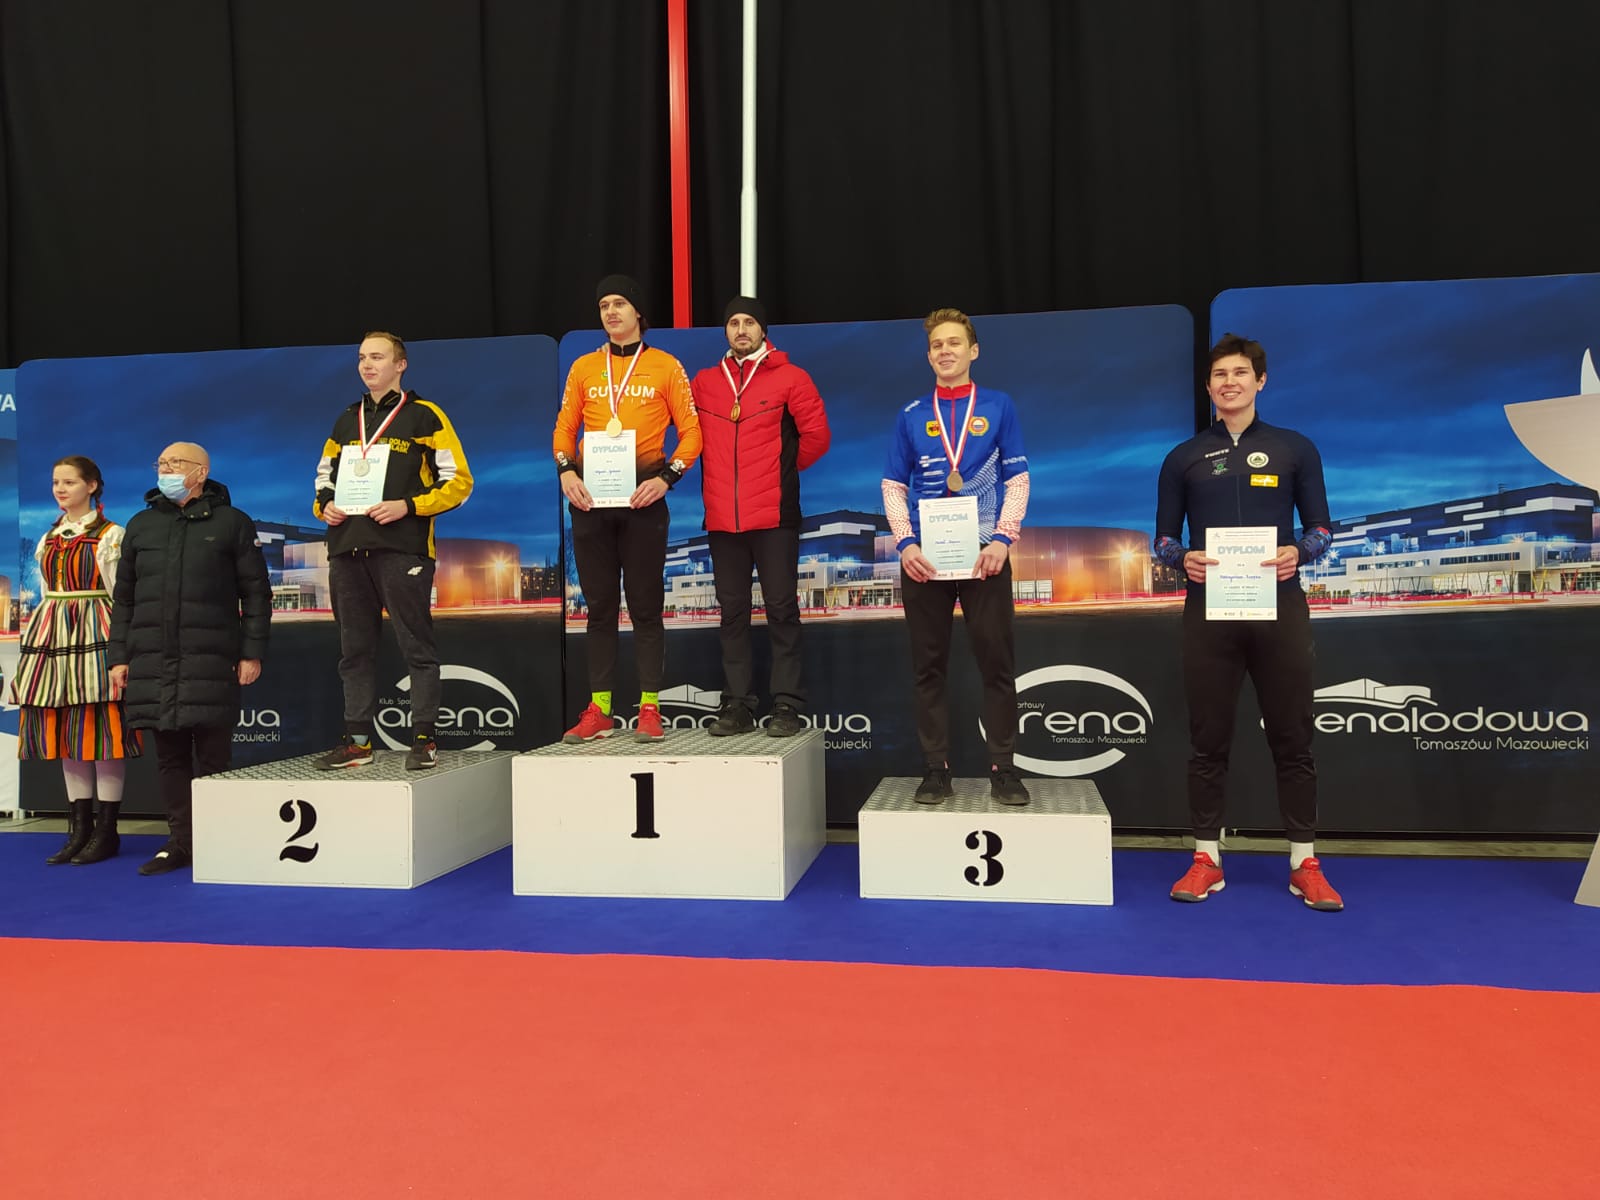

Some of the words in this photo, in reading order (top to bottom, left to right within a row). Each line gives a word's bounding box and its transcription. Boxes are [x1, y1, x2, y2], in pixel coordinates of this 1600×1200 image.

[588, 384, 656, 400] CUPRUM
[592, 445, 627, 453] DYPLOM
[347, 457, 380, 465] DYOM
[929, 512, 968, 523] DYPLOM
[1217, 545, 1266, 555] DYPLOM
[379, 697, 394, 705] Klub
[1017, 702, 1045, 710] ortowy
[1018, 711, 1147, 735] rena
[1312, 706, 1589, 734] enalodowa
[232, 731, 281, 743] zowiecki
[434, 728, 470, 737] Tomaszów
[473, 728, 514, 737] Mazowiecki
[824, 737, 872, 750] owiecki
[1052, 735, 1094, 745] Tomaszów
[1098, 735, 1147, 745] Mazowiecki
[1412, 736, 1492, 751] Tomaszów
[1496, 736, 1590, 751] Mazowiecki
[630, 772, 660, 839] 1
[279, 799, 319, 863] 2
[964, 830, 1004, 886] 3
